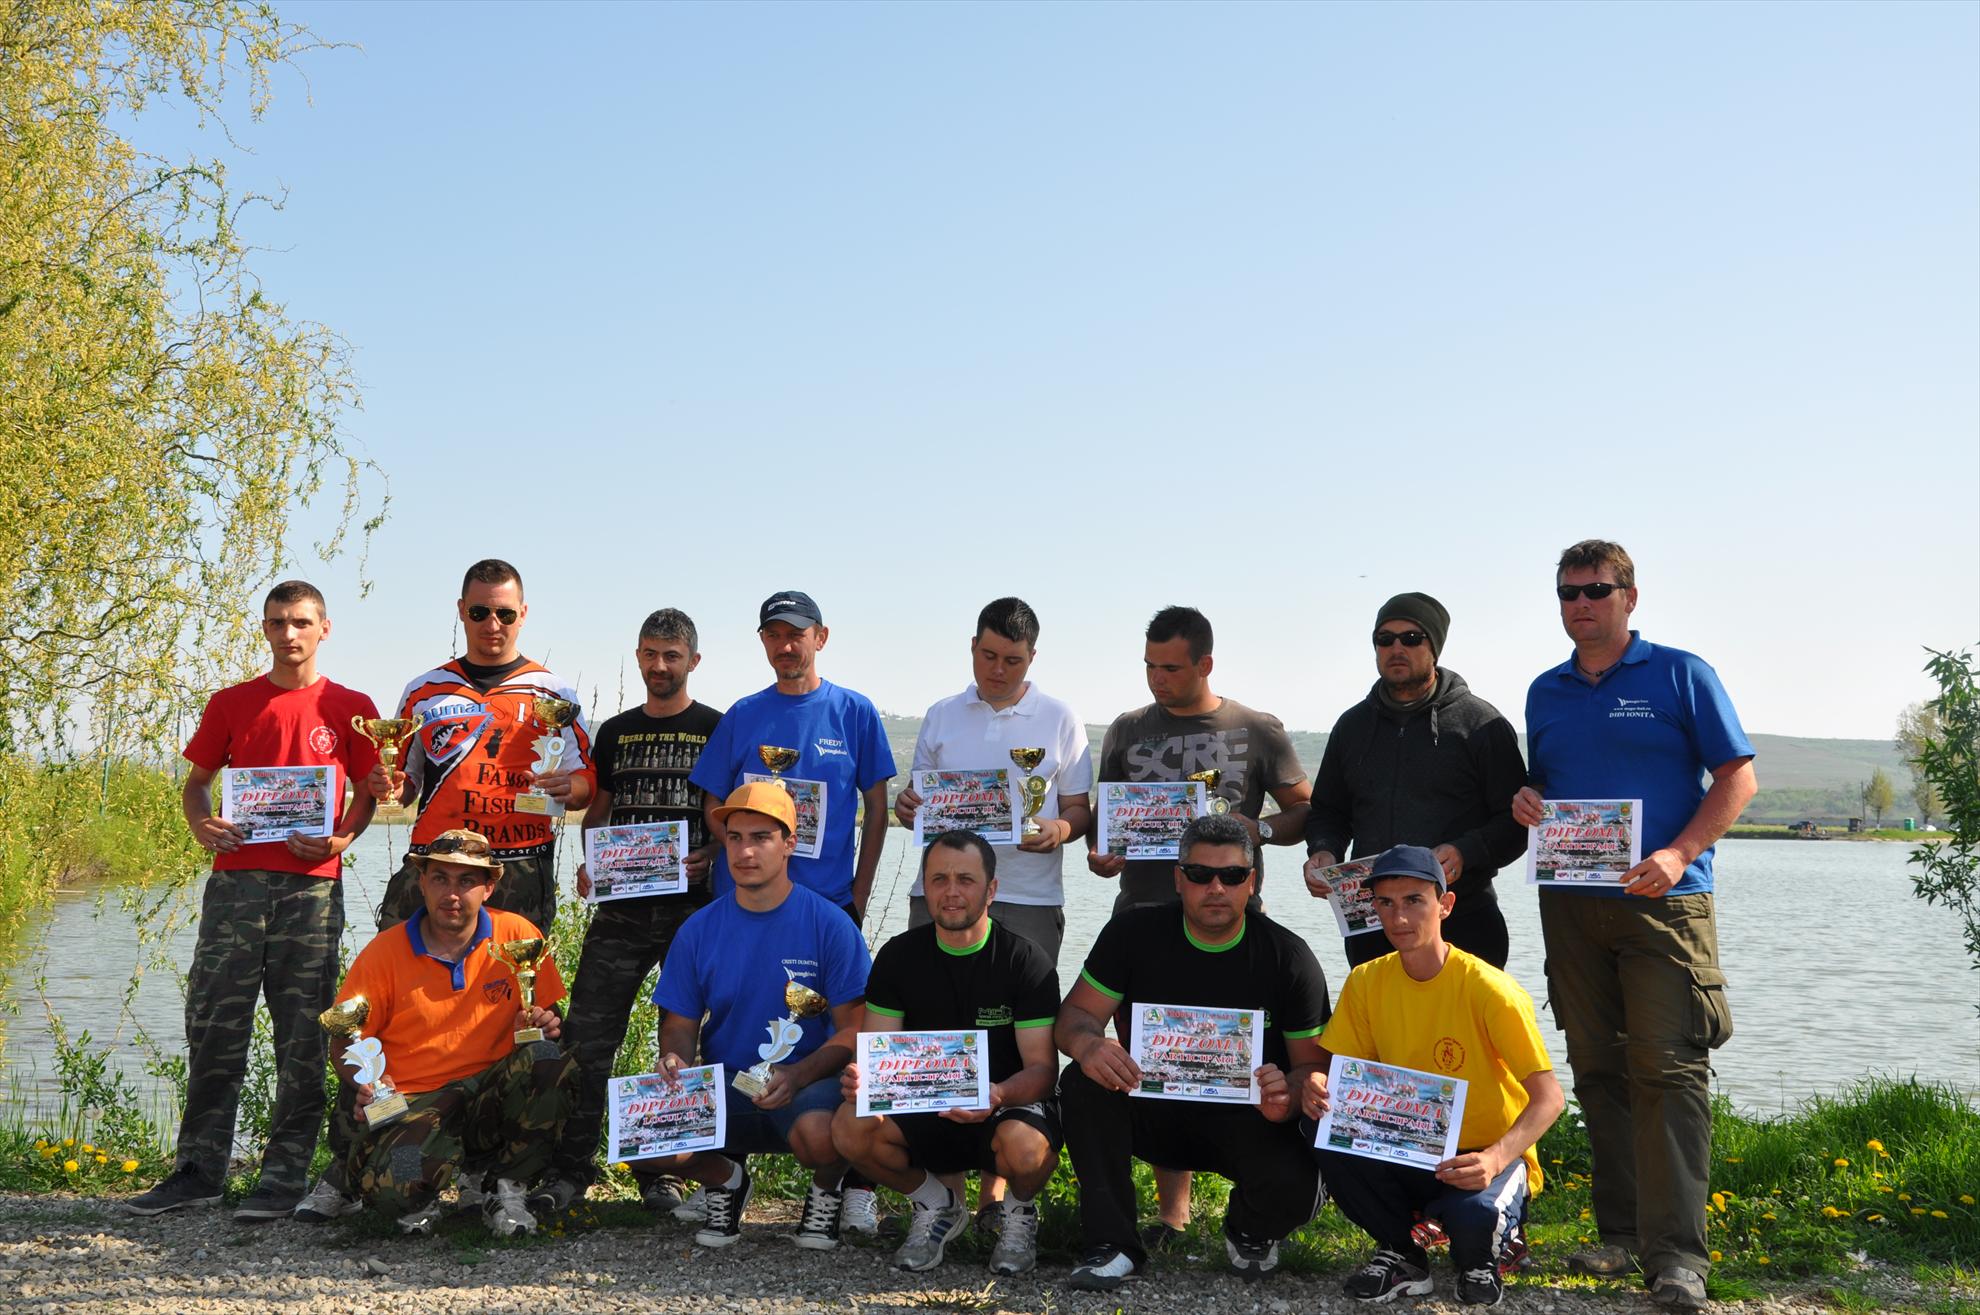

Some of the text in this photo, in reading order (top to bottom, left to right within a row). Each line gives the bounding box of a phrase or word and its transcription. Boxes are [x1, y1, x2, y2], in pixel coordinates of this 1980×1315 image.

[646, 734, 656, 742] OF
[659, 733, 675, 742] THE
[678, 732, 707, 744] WORLD
[819, 738, 843, 747] FREDY
[476, 762, 530, 787] FAMO
[241, 789, 320, 802] DIPLOMA
[931, 791, 1005, 804] DIPLOMA
[462, 790, 517, 815] FISH
[1115, 807, 1192, 817] DIPLOMA
[1545, 825, 1624, 838] DIPLOMA
[601, 844, 673, 859] DIPLOMA
[1152, 1034, 1243, 1051] DIPLOMA
[879, 1057, 970, 1071] DIPLOMA
[1153, 1052, 1236, 1063] PARTICIPARE
[880, 1074, 964, 1083] PARTICIPARE
[628, 1093, 709, 1115] DIPLOMA
[1346, 1089, 1442, 1119] DIPLOMA
[643, 1114, 682, 1126] LOCUL
[1345, 1107, 1433, 1130] PARTICIPARE
